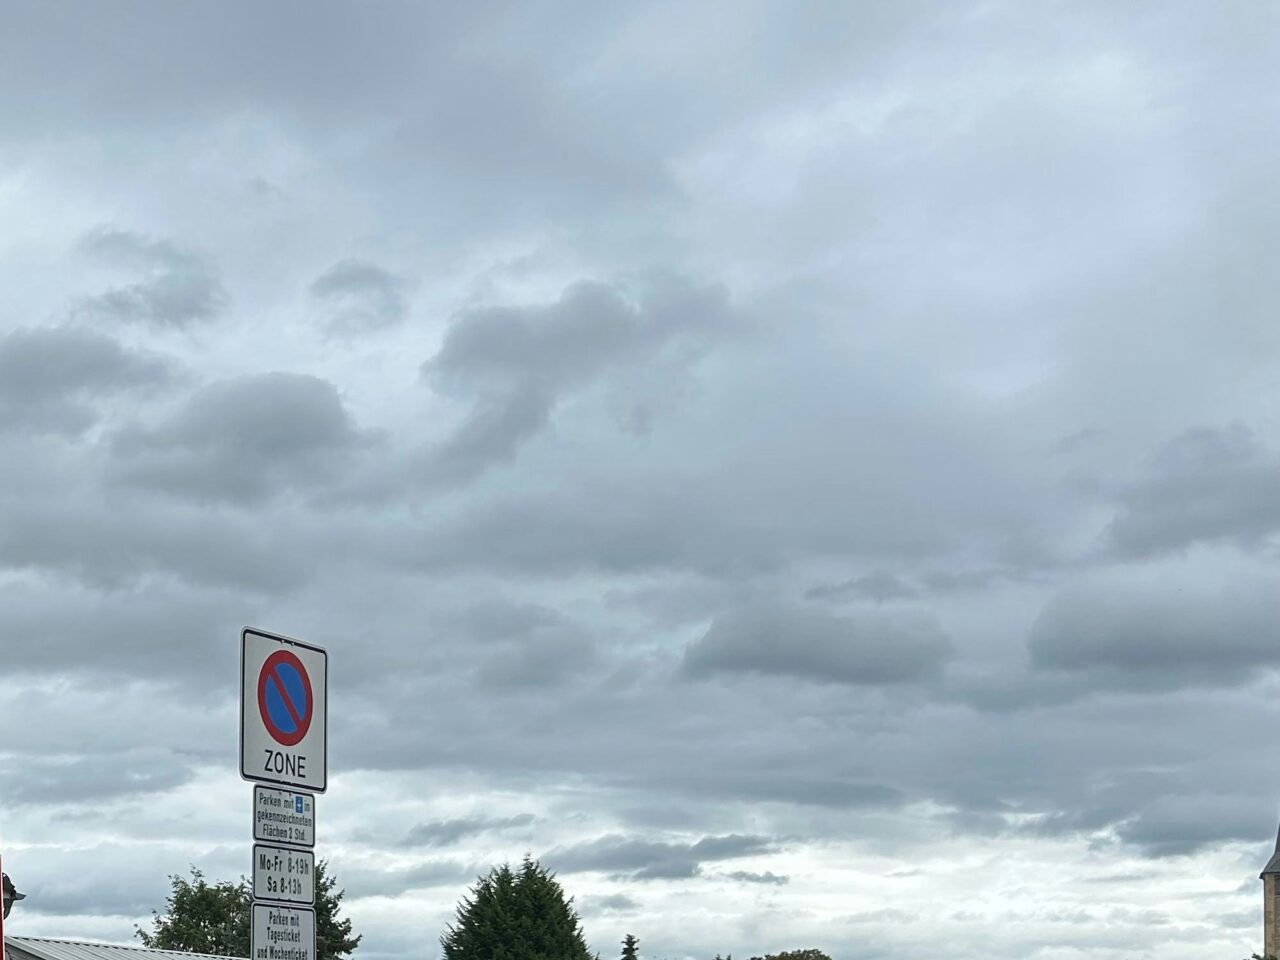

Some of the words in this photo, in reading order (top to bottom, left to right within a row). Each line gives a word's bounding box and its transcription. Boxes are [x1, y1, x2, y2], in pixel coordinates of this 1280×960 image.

[264, 748, 307, 779] ZONE
[259, 792, 282, 807] Parken
[283, 797, 294, 810] mit
[256, 810, 313, 828] gekennzeichneten
[262, 823, 288, 839] Flächen
[288, 826, 293, 840] 2
[259, 853, 283, 873] Mo-Fr
[287, 856, 309, 875] 8-19h
[267, 875, 278, 893] Sa
[280, 876, 302, 895] 8-13h
[269, 910, 289, 926] Parken
[290, 913, 300, 927] mit
[266, 926, 301, 944] Tagesticket
[257, 945, 268, 959] und
